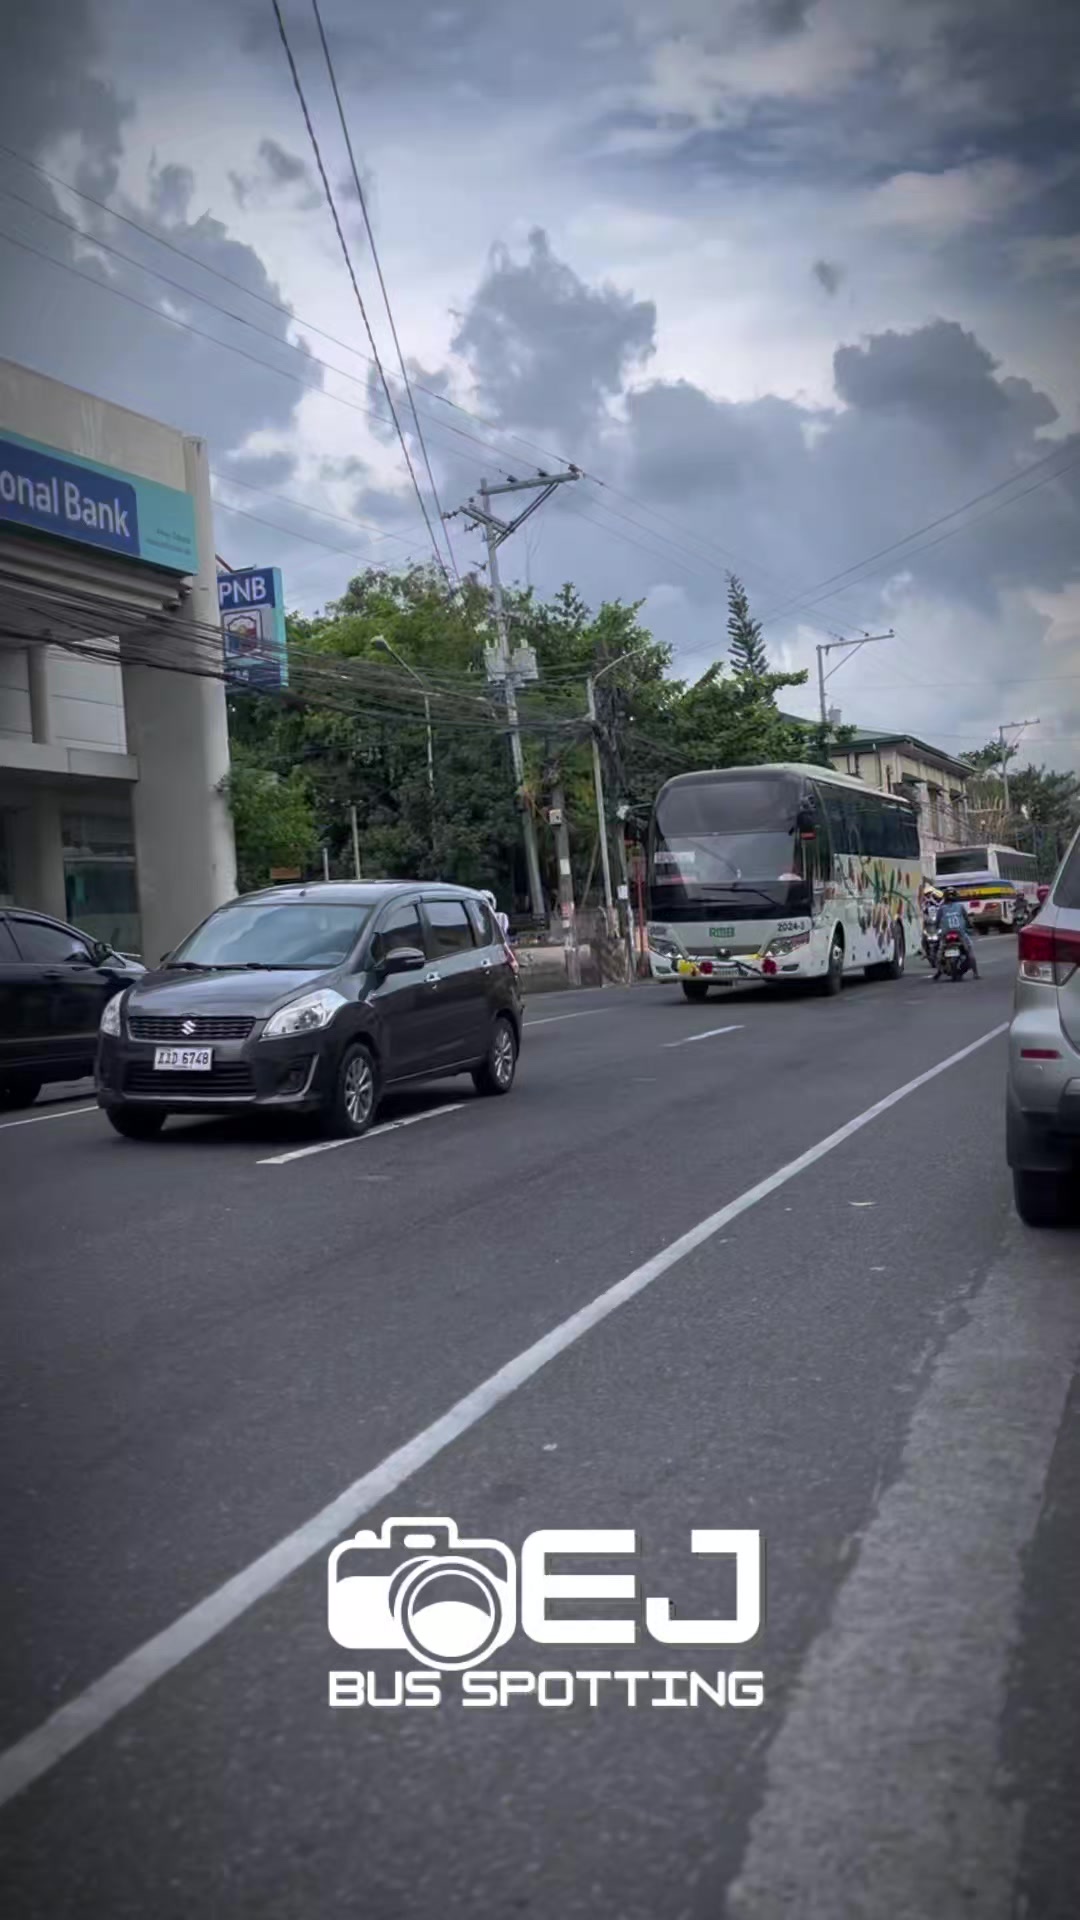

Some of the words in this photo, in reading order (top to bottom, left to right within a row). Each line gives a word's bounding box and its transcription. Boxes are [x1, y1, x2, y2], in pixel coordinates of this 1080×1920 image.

[64, 482, 131, 537] Bank
[219, 576, 267, 603] PNB
[182, 1052, 209, 1065] 6748
